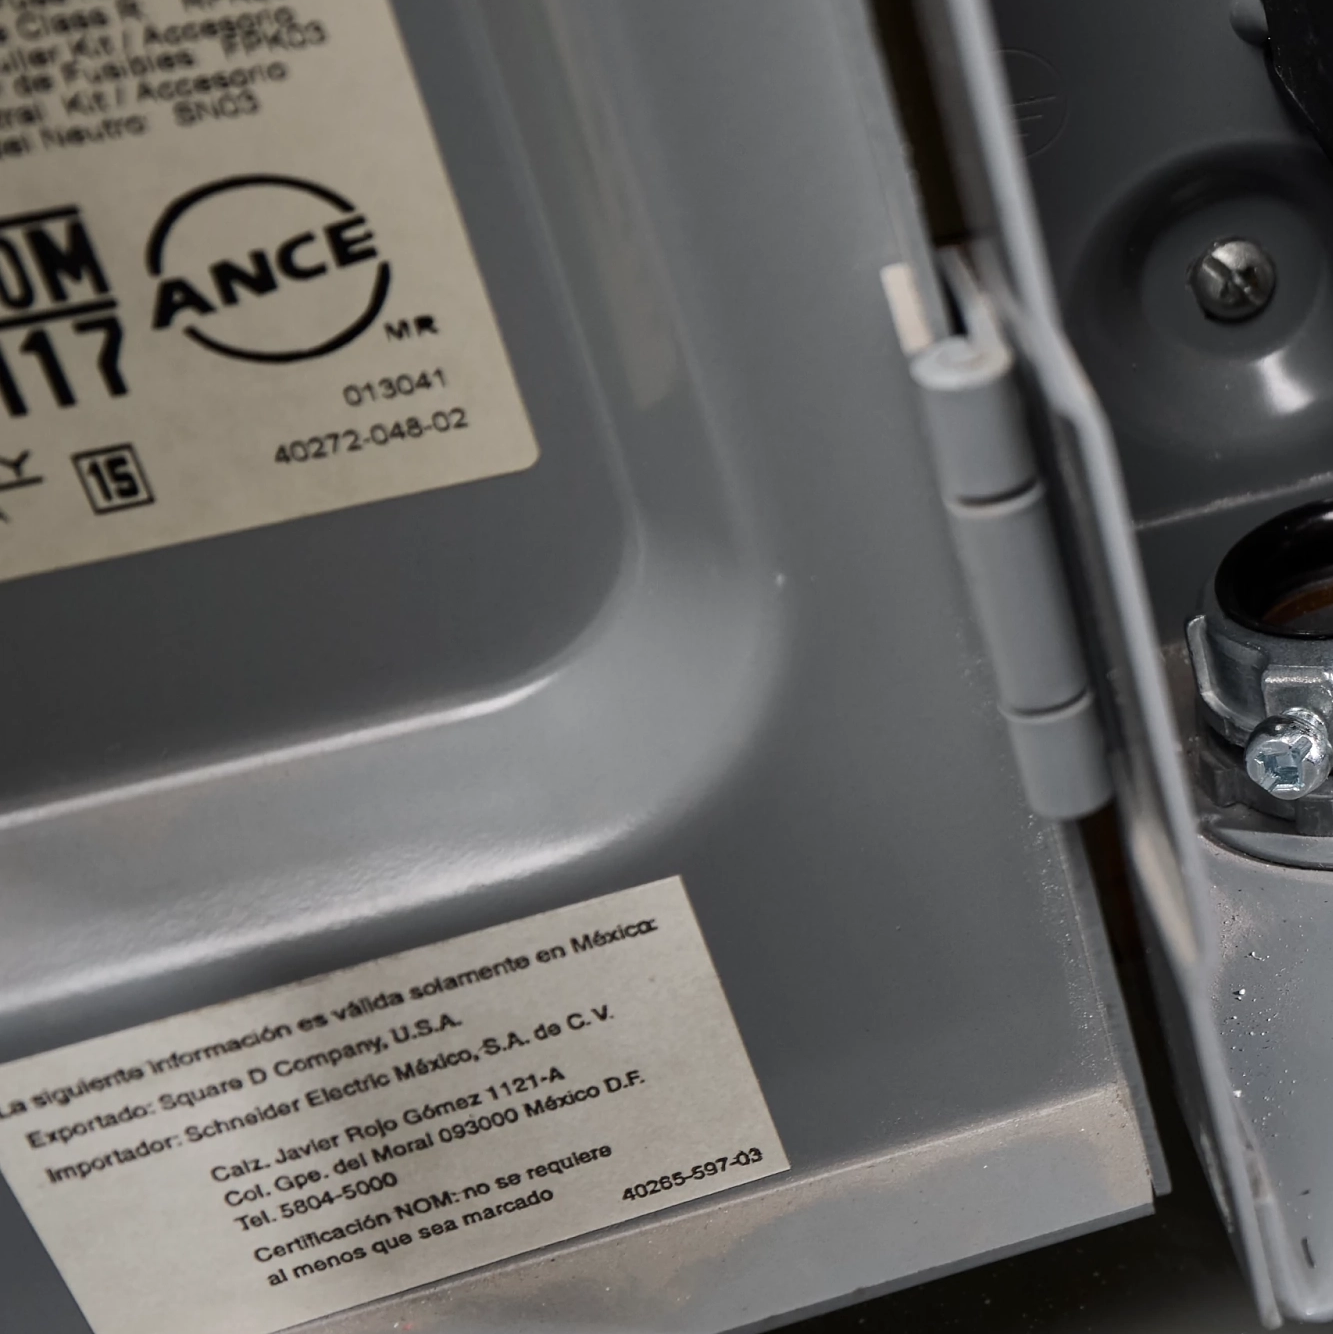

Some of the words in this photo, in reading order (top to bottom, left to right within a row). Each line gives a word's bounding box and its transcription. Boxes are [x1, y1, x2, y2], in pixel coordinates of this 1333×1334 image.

[152, 215, 378, 330] ANCE
[384, 315, 441, 343] MR
[274, 407, 470, 465] 40272-048-02
[343, 368, 447, 407] 013041
[26, 1104, 156, 1151] Exportado:
[158, 1078, 243, 1112] Square
[247, 1067, 267, 1086] D
[273, 1035, 389, 1078] Company,
[391, 1014, 463, 1044] U.S.A.
[31, 1065, 145, 1107] siguiente
[149, 1023, 293, 1074] información
[297, 1010, 329, 1033] es
[331, 991, 405, 1023] válida
[409, 955, 530, 1000] solamente
[536, 946, 566, 964] en
[45, 1134, 182, 1185] Importador:
[184, 1095, 300, 1144] Schneider
[304, 1073, 391, 1108] Electric
[393, 1048, 480, 1084] México,
[482, 1031, 531, 1057] S.A.
[534, 1022, 562, 1041] de
[210, 1159, 271, 1183] Calz.
[275, 1135, 339, 1165] Javier
[344, 1119, 398, 1144] Rojo
[403, 1092, 482, 1126] Gómez
[486, 1067, 566, 1102] 1121-A
[224, 1185, 271, 1208] Col.
[274, 1169, 330, 1194] Gpe.
[333, 1153, 368, 1176] del
[370, 1131, 435, 1163] Moral
[439, 1108, 519, 1143] 093000
[523, 1082, 600, 1118] México
[603, 1069, 645, 1094] D.F.
[234, 1209, 277, 1233] Tel.
[279, 1171, 398, 1220] 5804-5000
[254, 1211, 393, 1263] Certificación
[393, 1189, 460, 1221] NOM:
[463, 1181, 490, 1199] no
[494, 1173, 521, 1189] se
[527, 1143, 612, 1181] requiere
[267, 1268, 288, 1287] al
[293, 1247, 367, 1279] menos
[372, 1233, 413, 1255] que
[418, 1218, 458, 1240] sea
[462, 1187, 554, 1227] marcado
